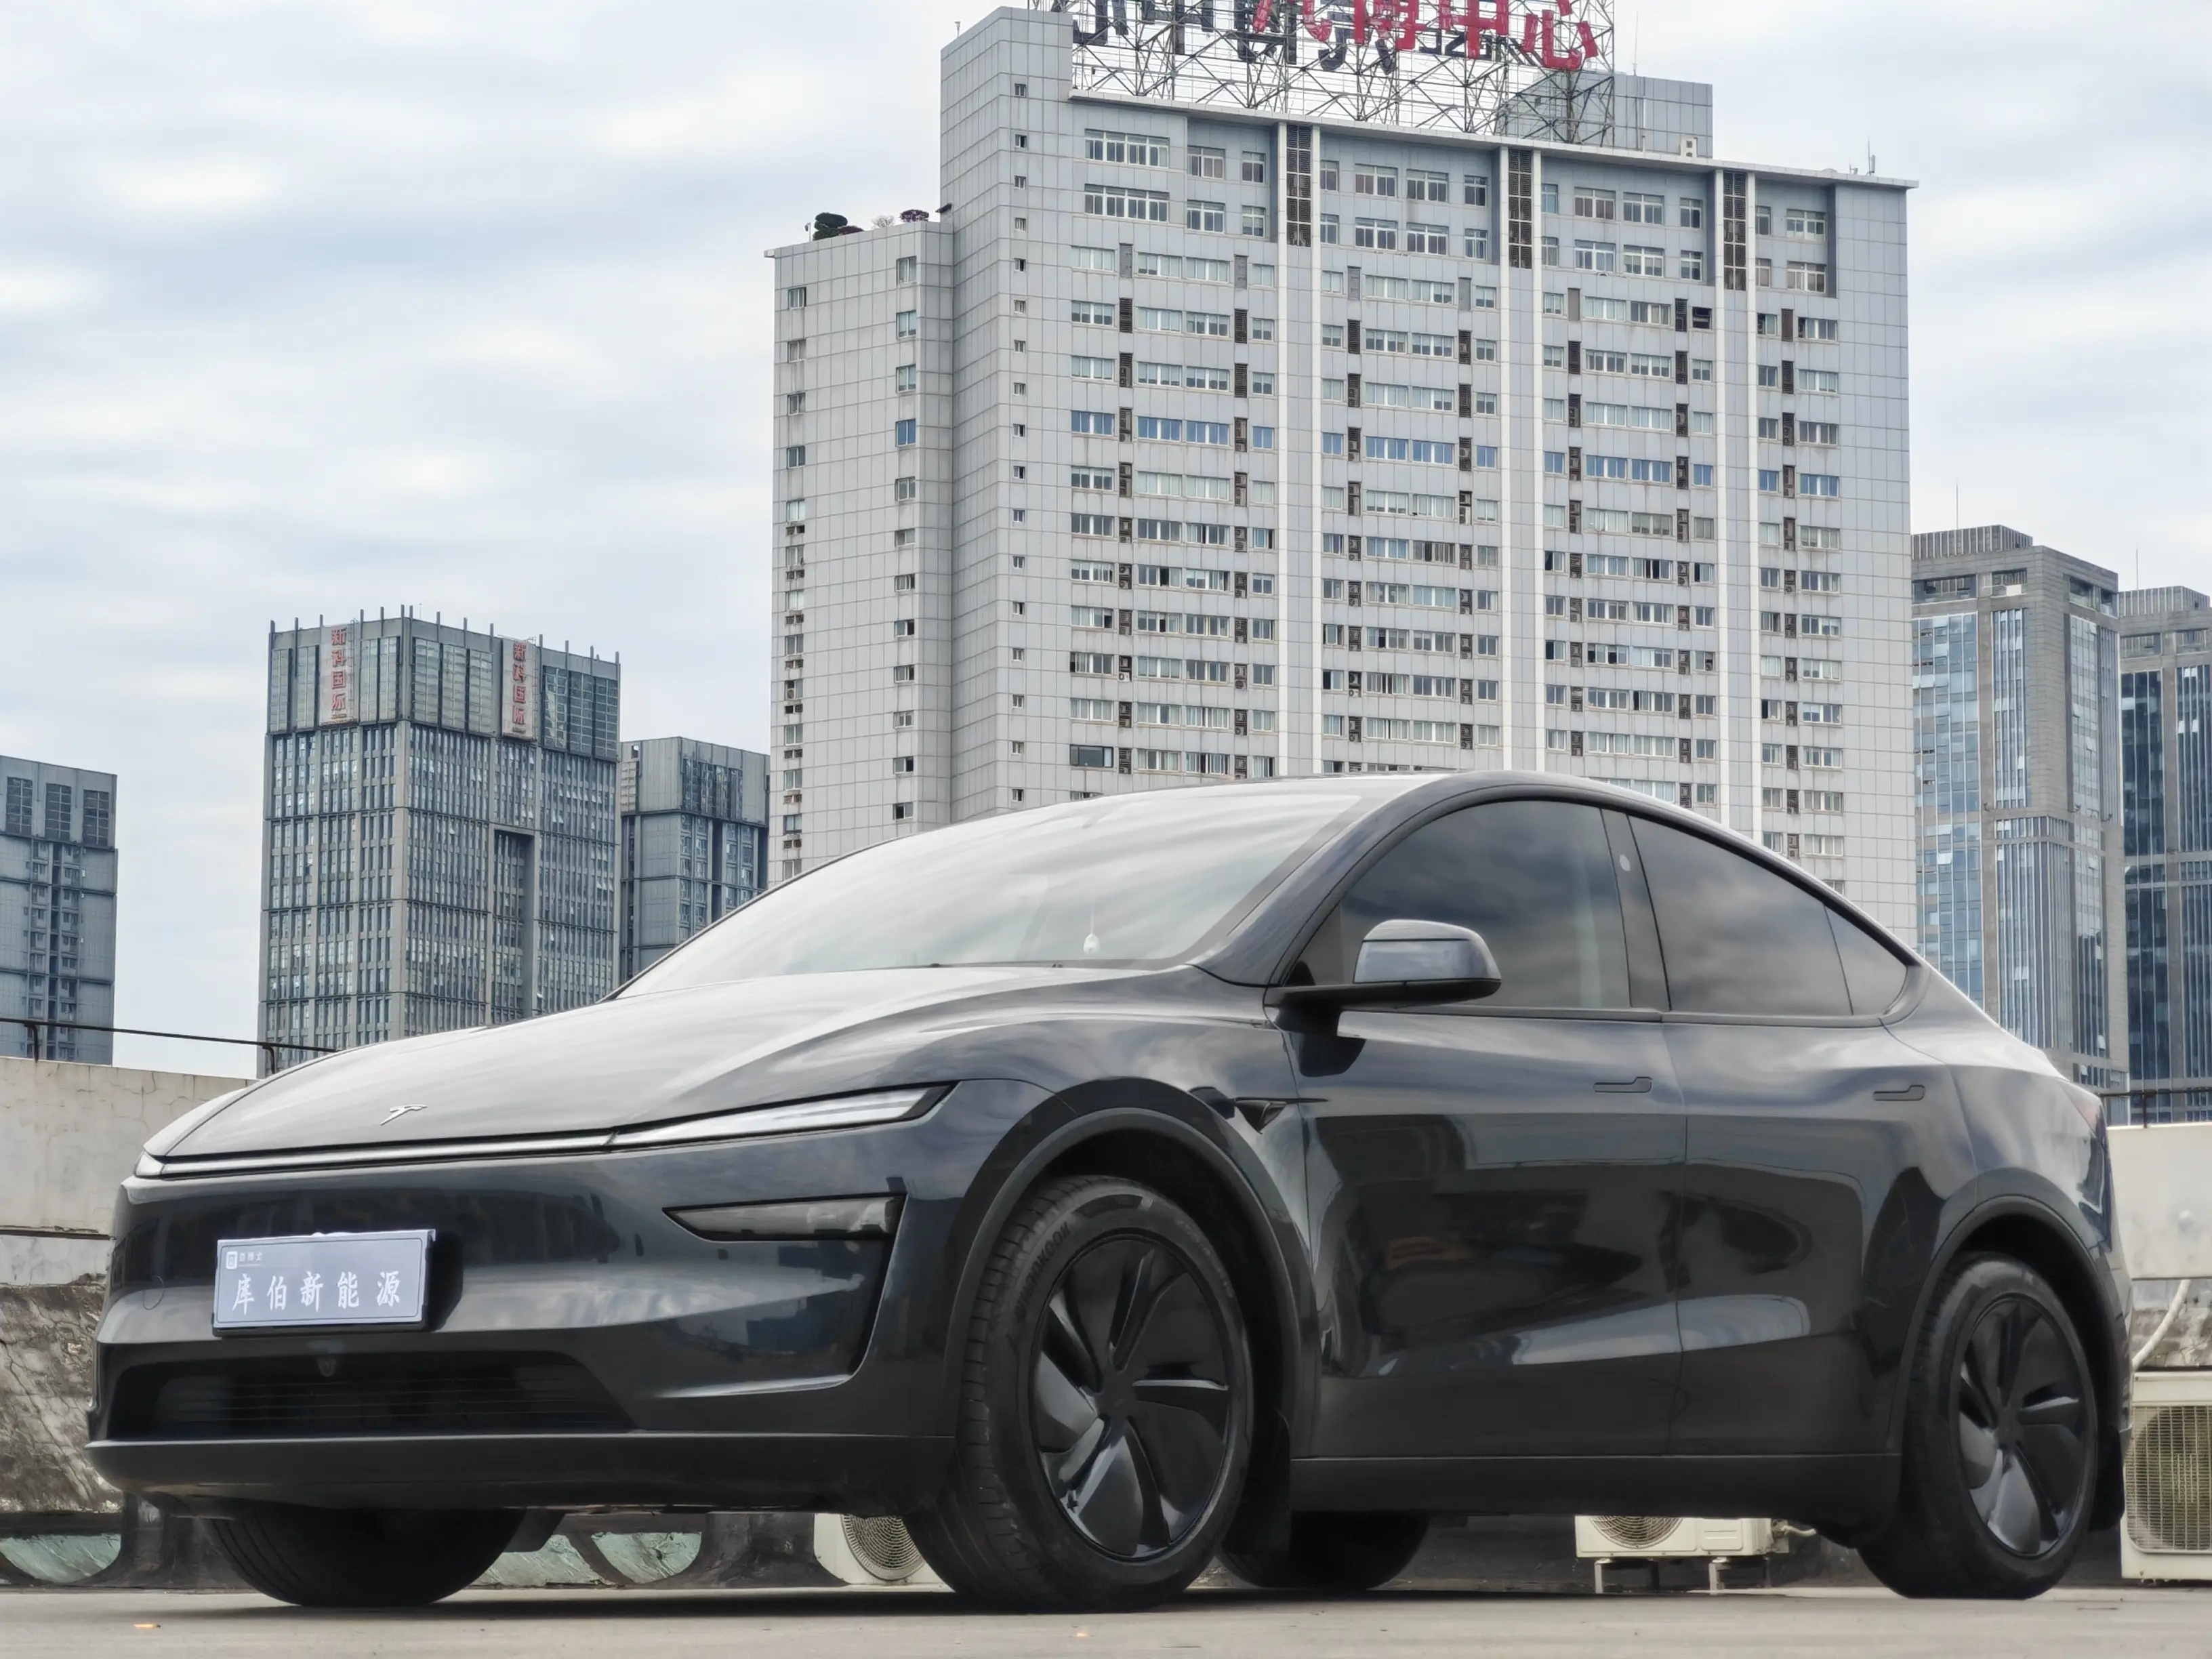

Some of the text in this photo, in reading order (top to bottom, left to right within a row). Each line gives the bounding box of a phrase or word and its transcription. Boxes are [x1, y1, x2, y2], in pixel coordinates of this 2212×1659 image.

[232, 1271, 401, 1315] 库伯新能源
